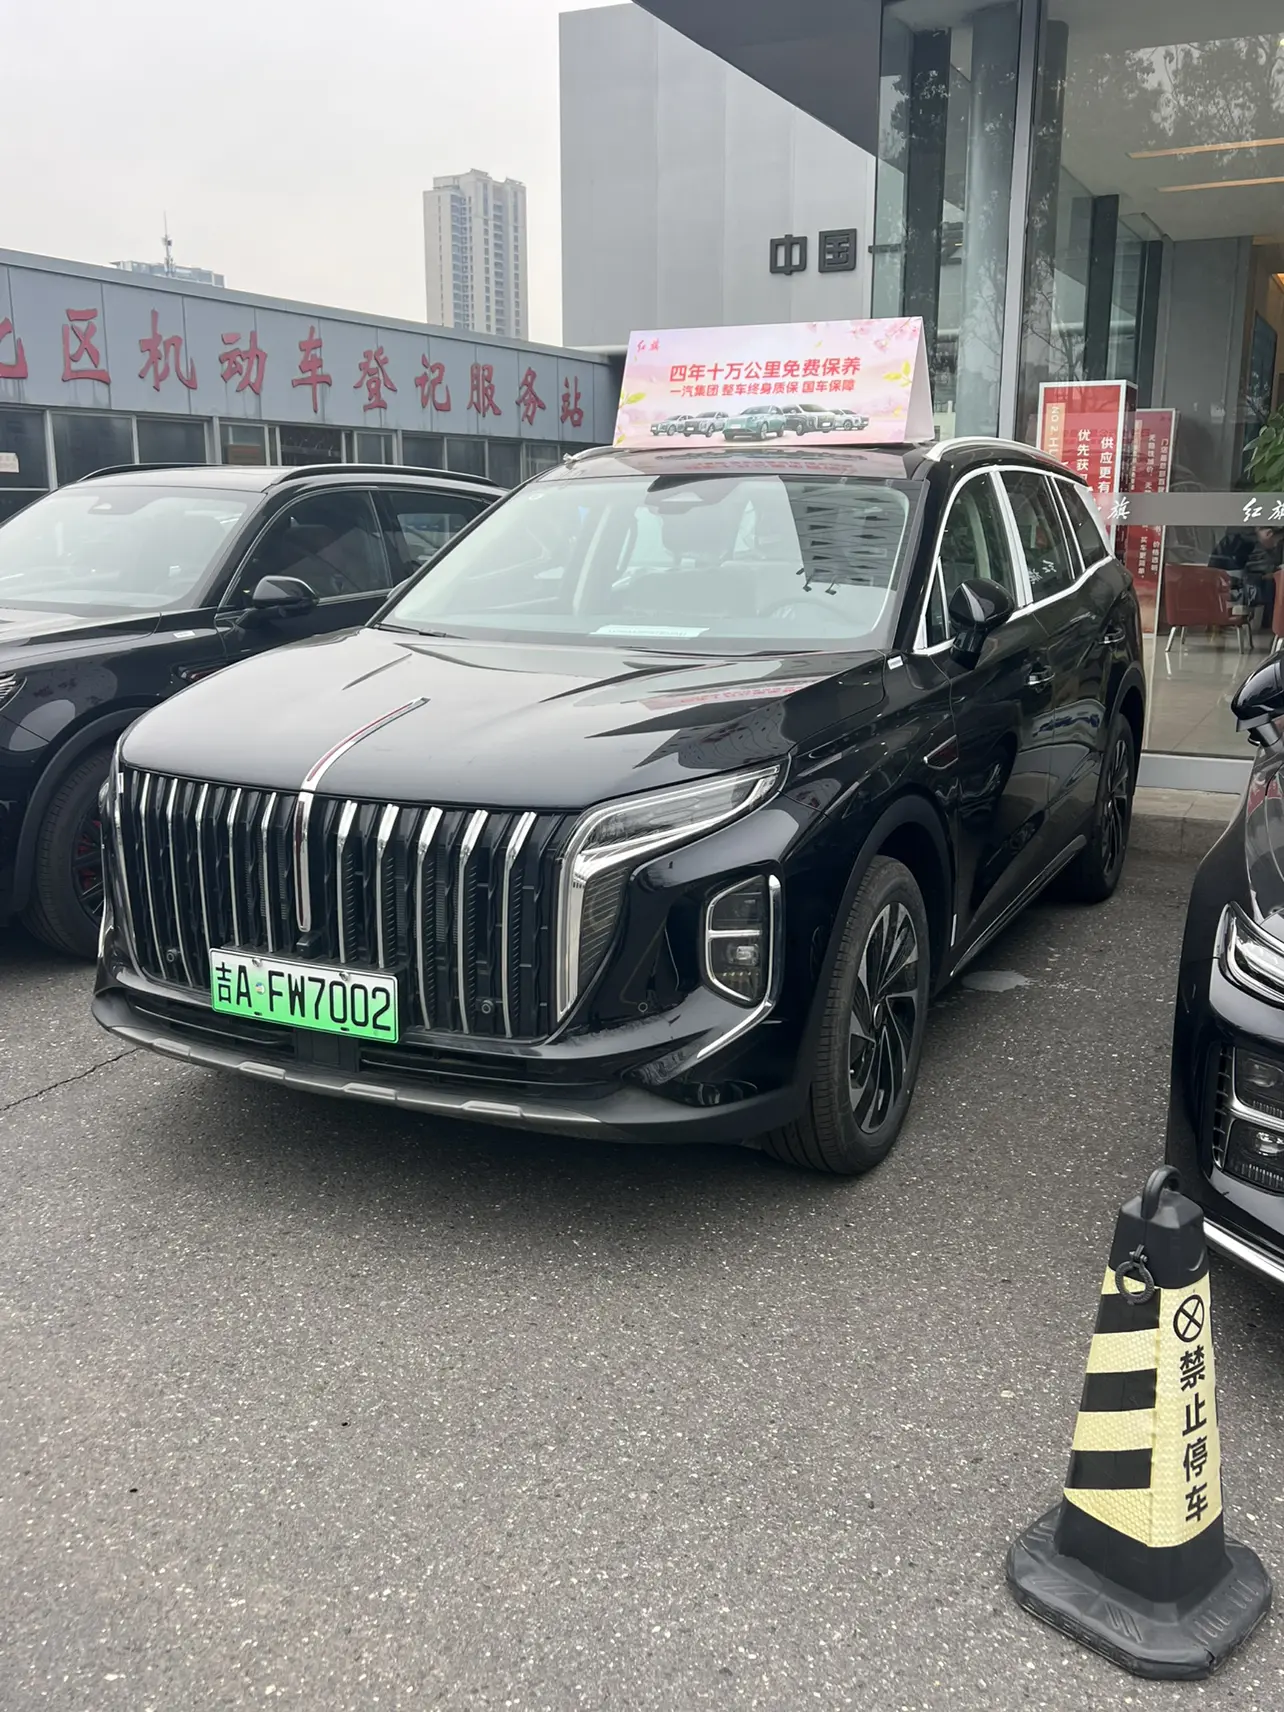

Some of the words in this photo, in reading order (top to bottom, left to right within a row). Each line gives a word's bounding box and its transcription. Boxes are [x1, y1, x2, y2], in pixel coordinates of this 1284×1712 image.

[669, 356, 861, 382] 四年十万公里免费保养
[670, 384, 719, 398] 一汽集团
[721, 382, 799, 397] 整车终身质保
[802, 379, 856, 394] 国车保障
[1242, 497, 1284, 522] 红旗
[1179, 1345, 1209, 1522] 禁止停车
